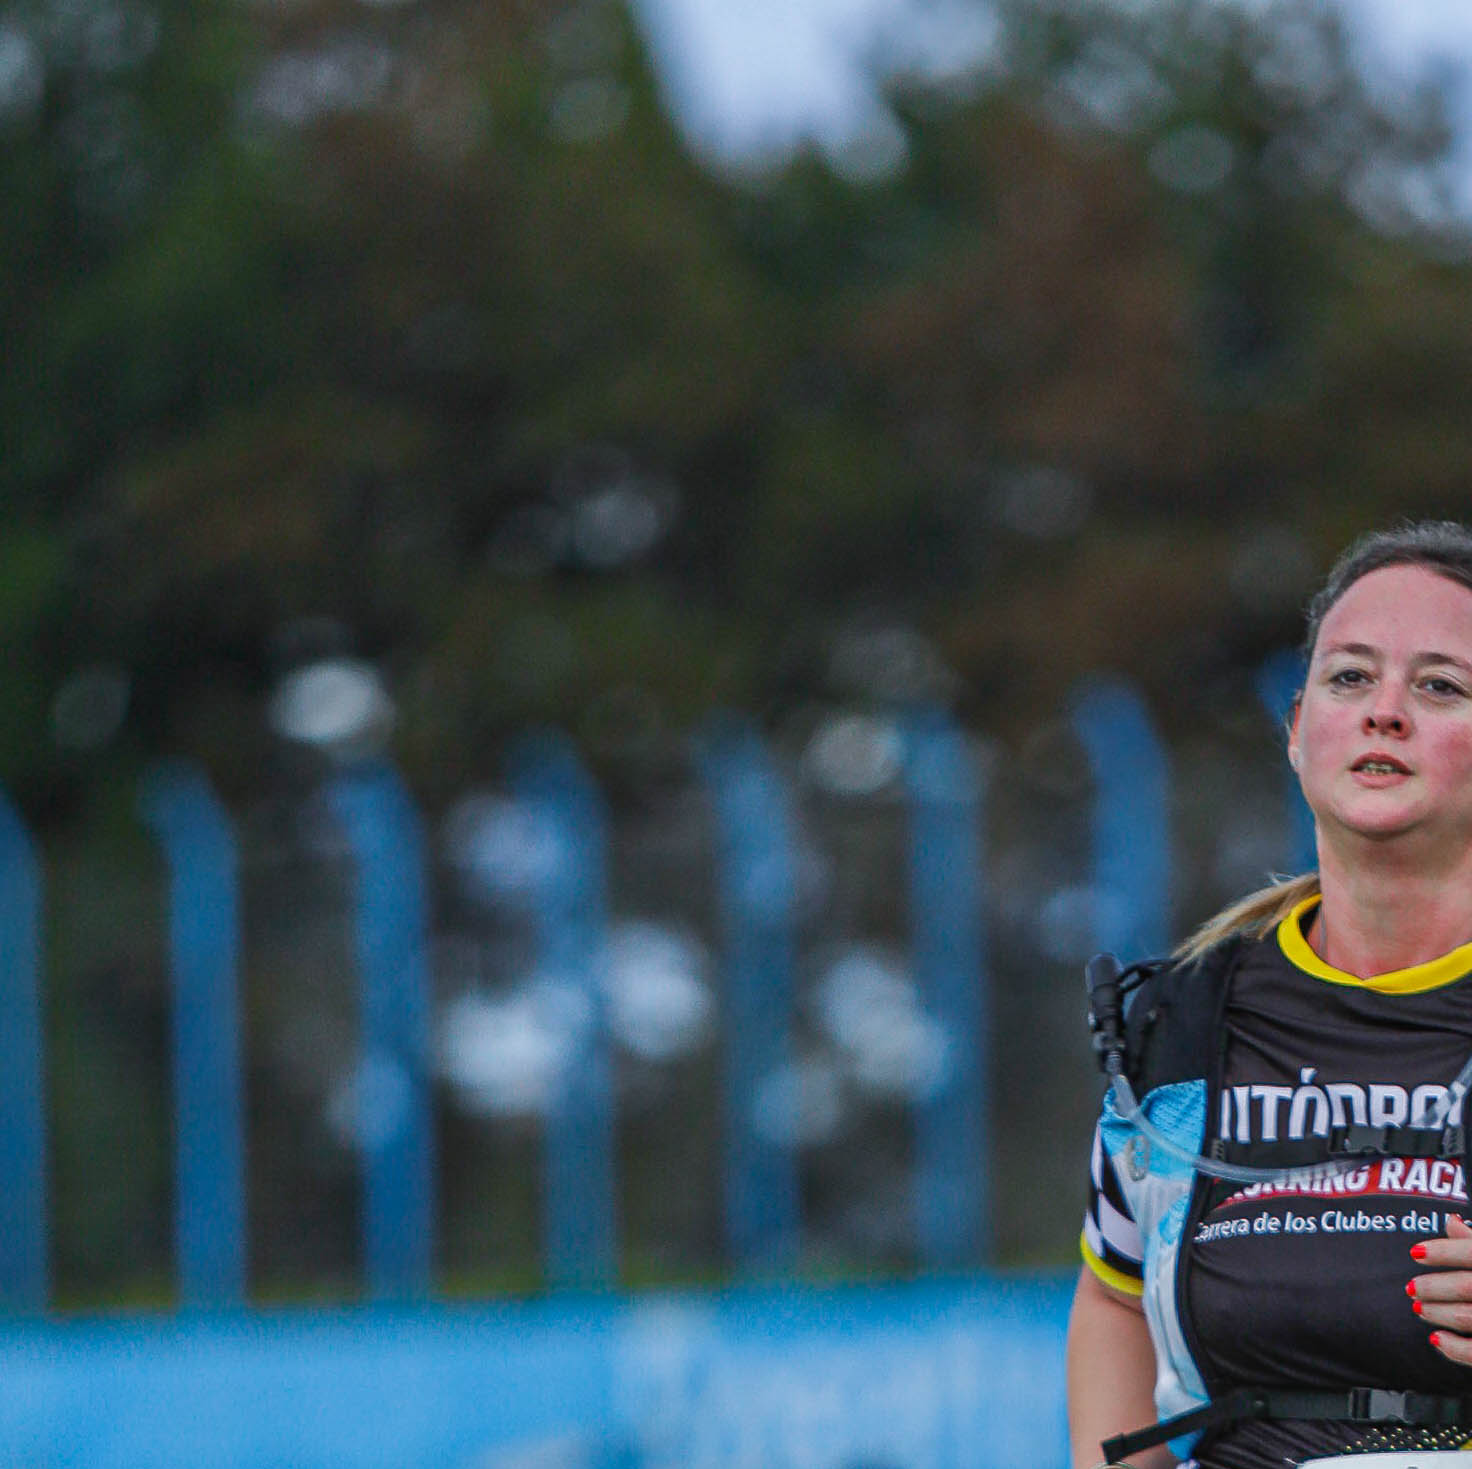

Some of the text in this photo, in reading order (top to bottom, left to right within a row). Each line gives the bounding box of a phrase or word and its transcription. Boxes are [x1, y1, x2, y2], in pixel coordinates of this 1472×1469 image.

[1194, 1218, 1250, 1241] arrera
[1253, 1211, 1281, 1234] de
[1284, 1211, 1318, 1233] los
[1321, 1210, 1397, 1232] Clubes
[1402, 1210, 1438, 1232] del
